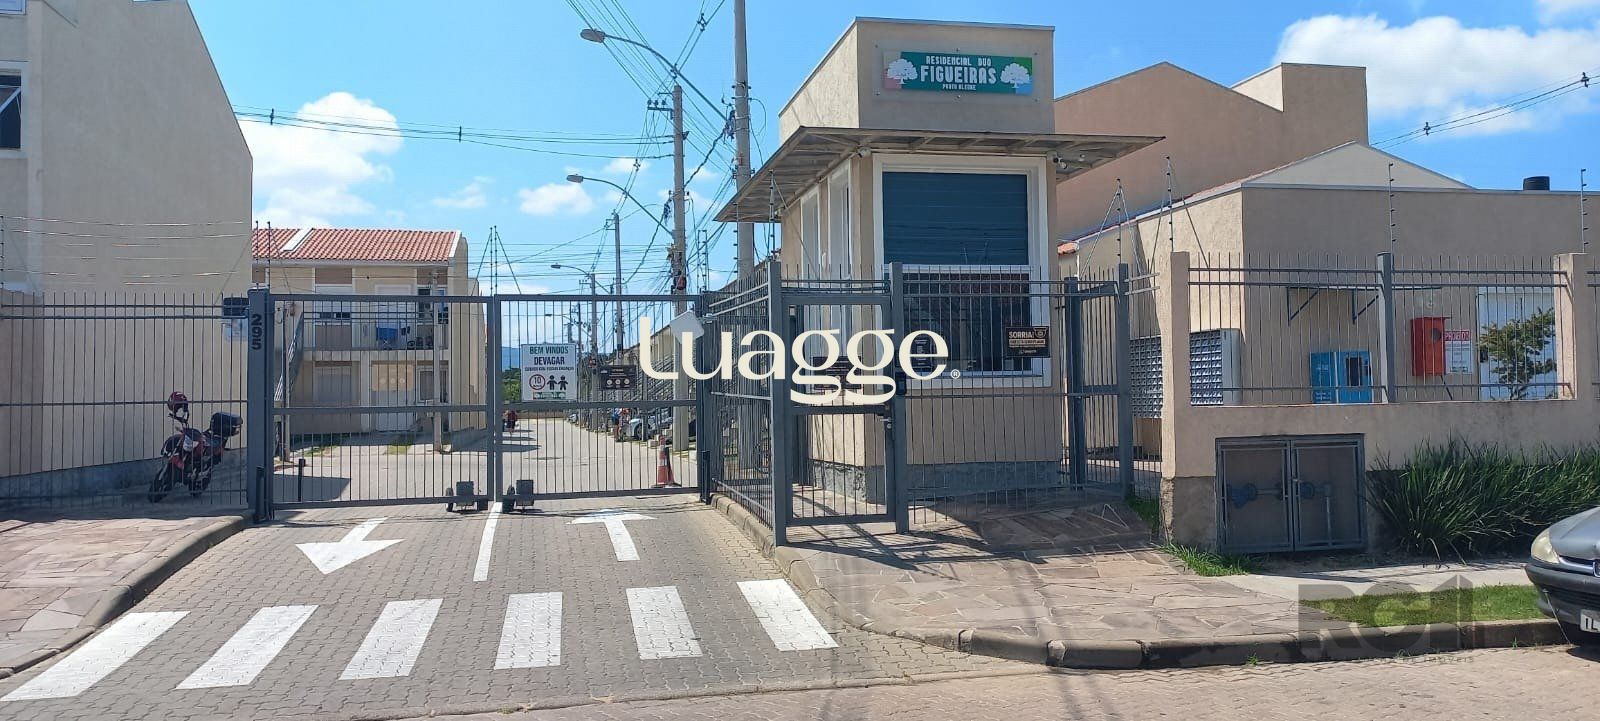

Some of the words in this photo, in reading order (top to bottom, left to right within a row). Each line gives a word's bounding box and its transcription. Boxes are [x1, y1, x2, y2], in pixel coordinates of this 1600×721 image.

[926, 56, 971, 66] RESIDENCIAL
[977, 58, 991, 66] DUO
[920, 66, 997, 84] FIGUEIRAS
[251, 313, 262, 350] 295
[529, 346, 543, 354] BEM
[545, 346, 569, 354] VINDOS
[534, 357, 565, 365] DEVAGAR
